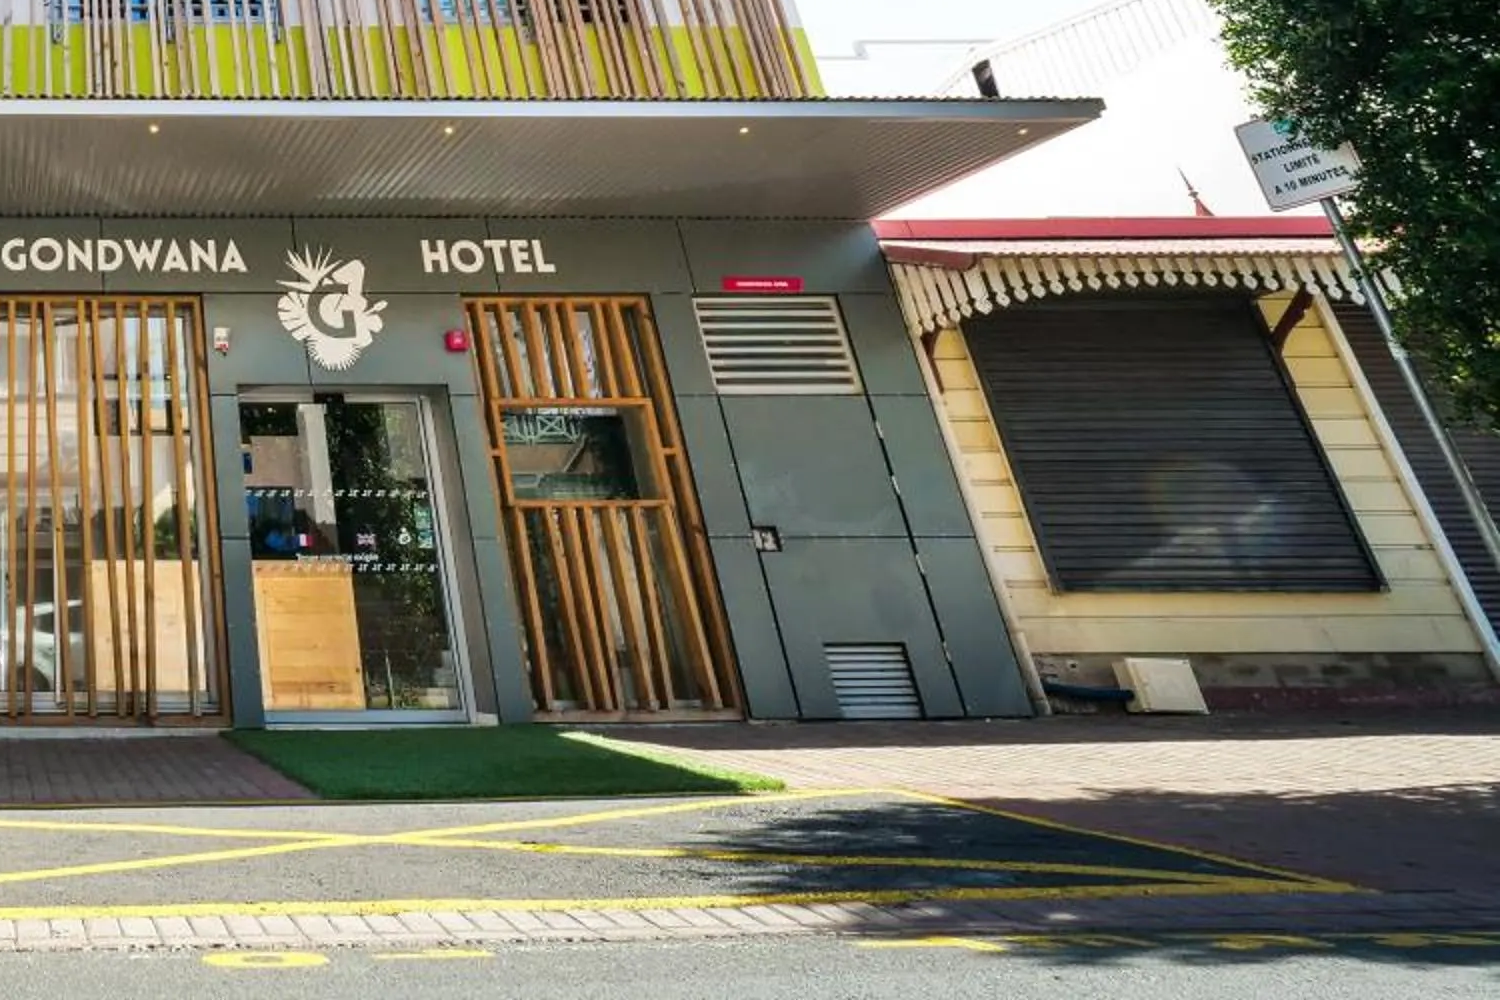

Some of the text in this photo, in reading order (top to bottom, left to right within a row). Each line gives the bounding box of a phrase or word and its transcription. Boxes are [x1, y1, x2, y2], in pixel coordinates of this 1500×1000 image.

[1298, 164, 1349, 186] MINUTES
[1, 237, 557, 273] GONDWANA HOTEL
